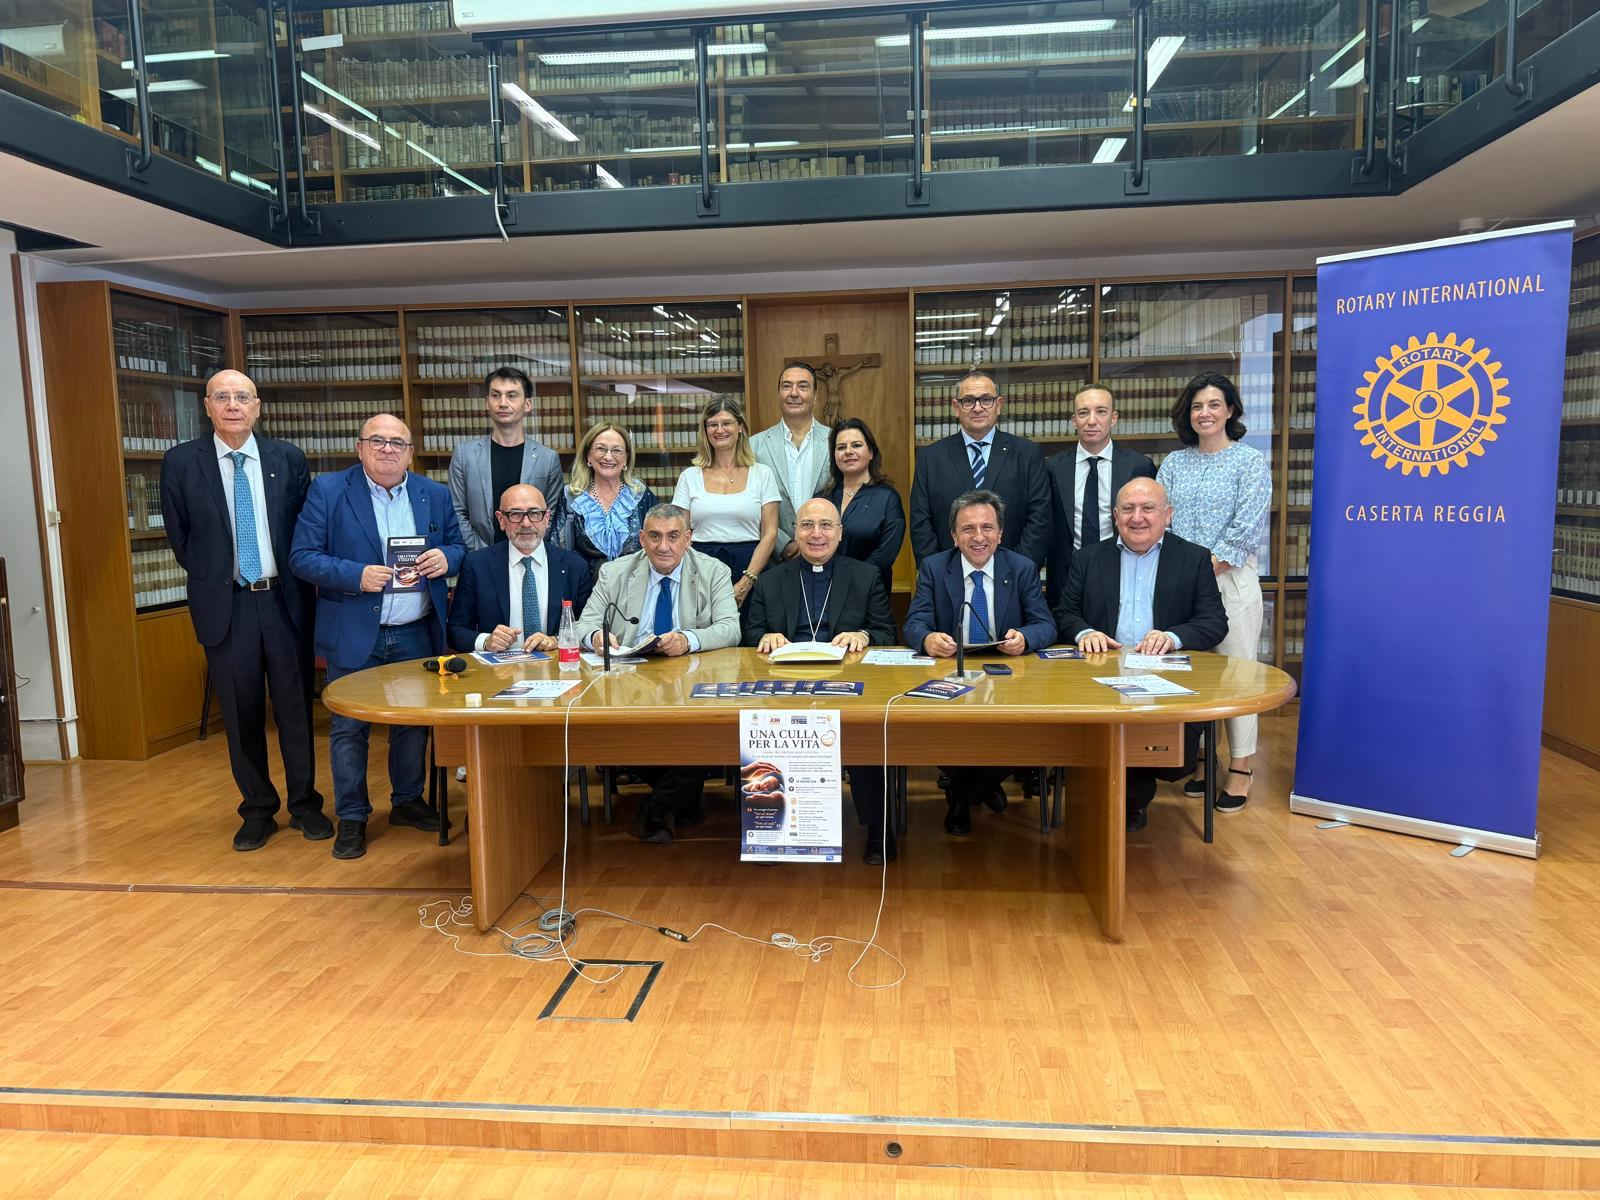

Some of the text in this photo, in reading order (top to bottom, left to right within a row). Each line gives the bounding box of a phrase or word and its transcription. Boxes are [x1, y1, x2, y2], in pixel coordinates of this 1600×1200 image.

[1336, 274, 1545, 315] ROTARY INTERNATIONAL
[1399, 347, 1465, 368] ROTARY
[1375, 424, 1485, 461] INTERNATIONAL
[1345, 504, 1506, 523] CASERTA REGGIA
[749, 740, 820, 749] PER LA VITA
[750, 730, 818, 739] UNA CULLA
